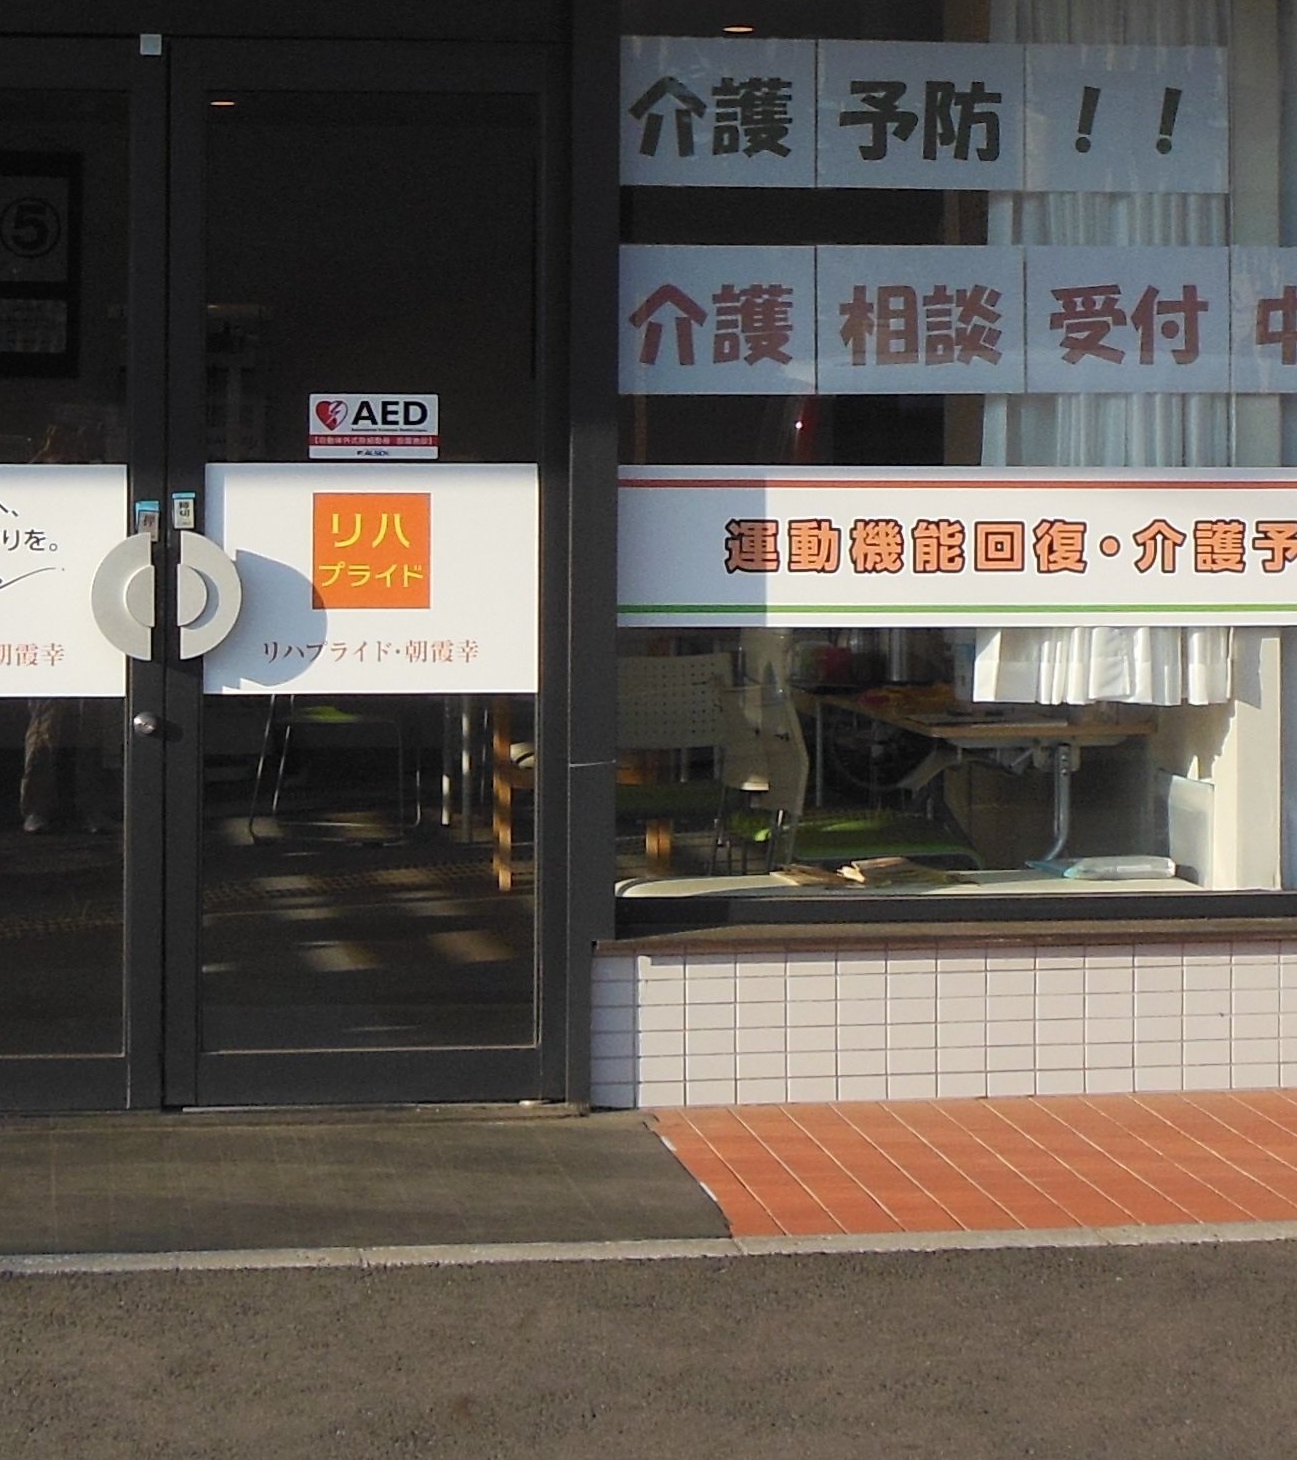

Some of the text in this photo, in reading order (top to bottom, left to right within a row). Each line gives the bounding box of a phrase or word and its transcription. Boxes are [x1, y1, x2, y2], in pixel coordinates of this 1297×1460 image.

[351, 400, 429, 426] AED
[331, 512, 411, 548] リハ
[318, 560, 424, 589] プライド
[262, 639, 480, 665] リハプライド・朝霞幸
